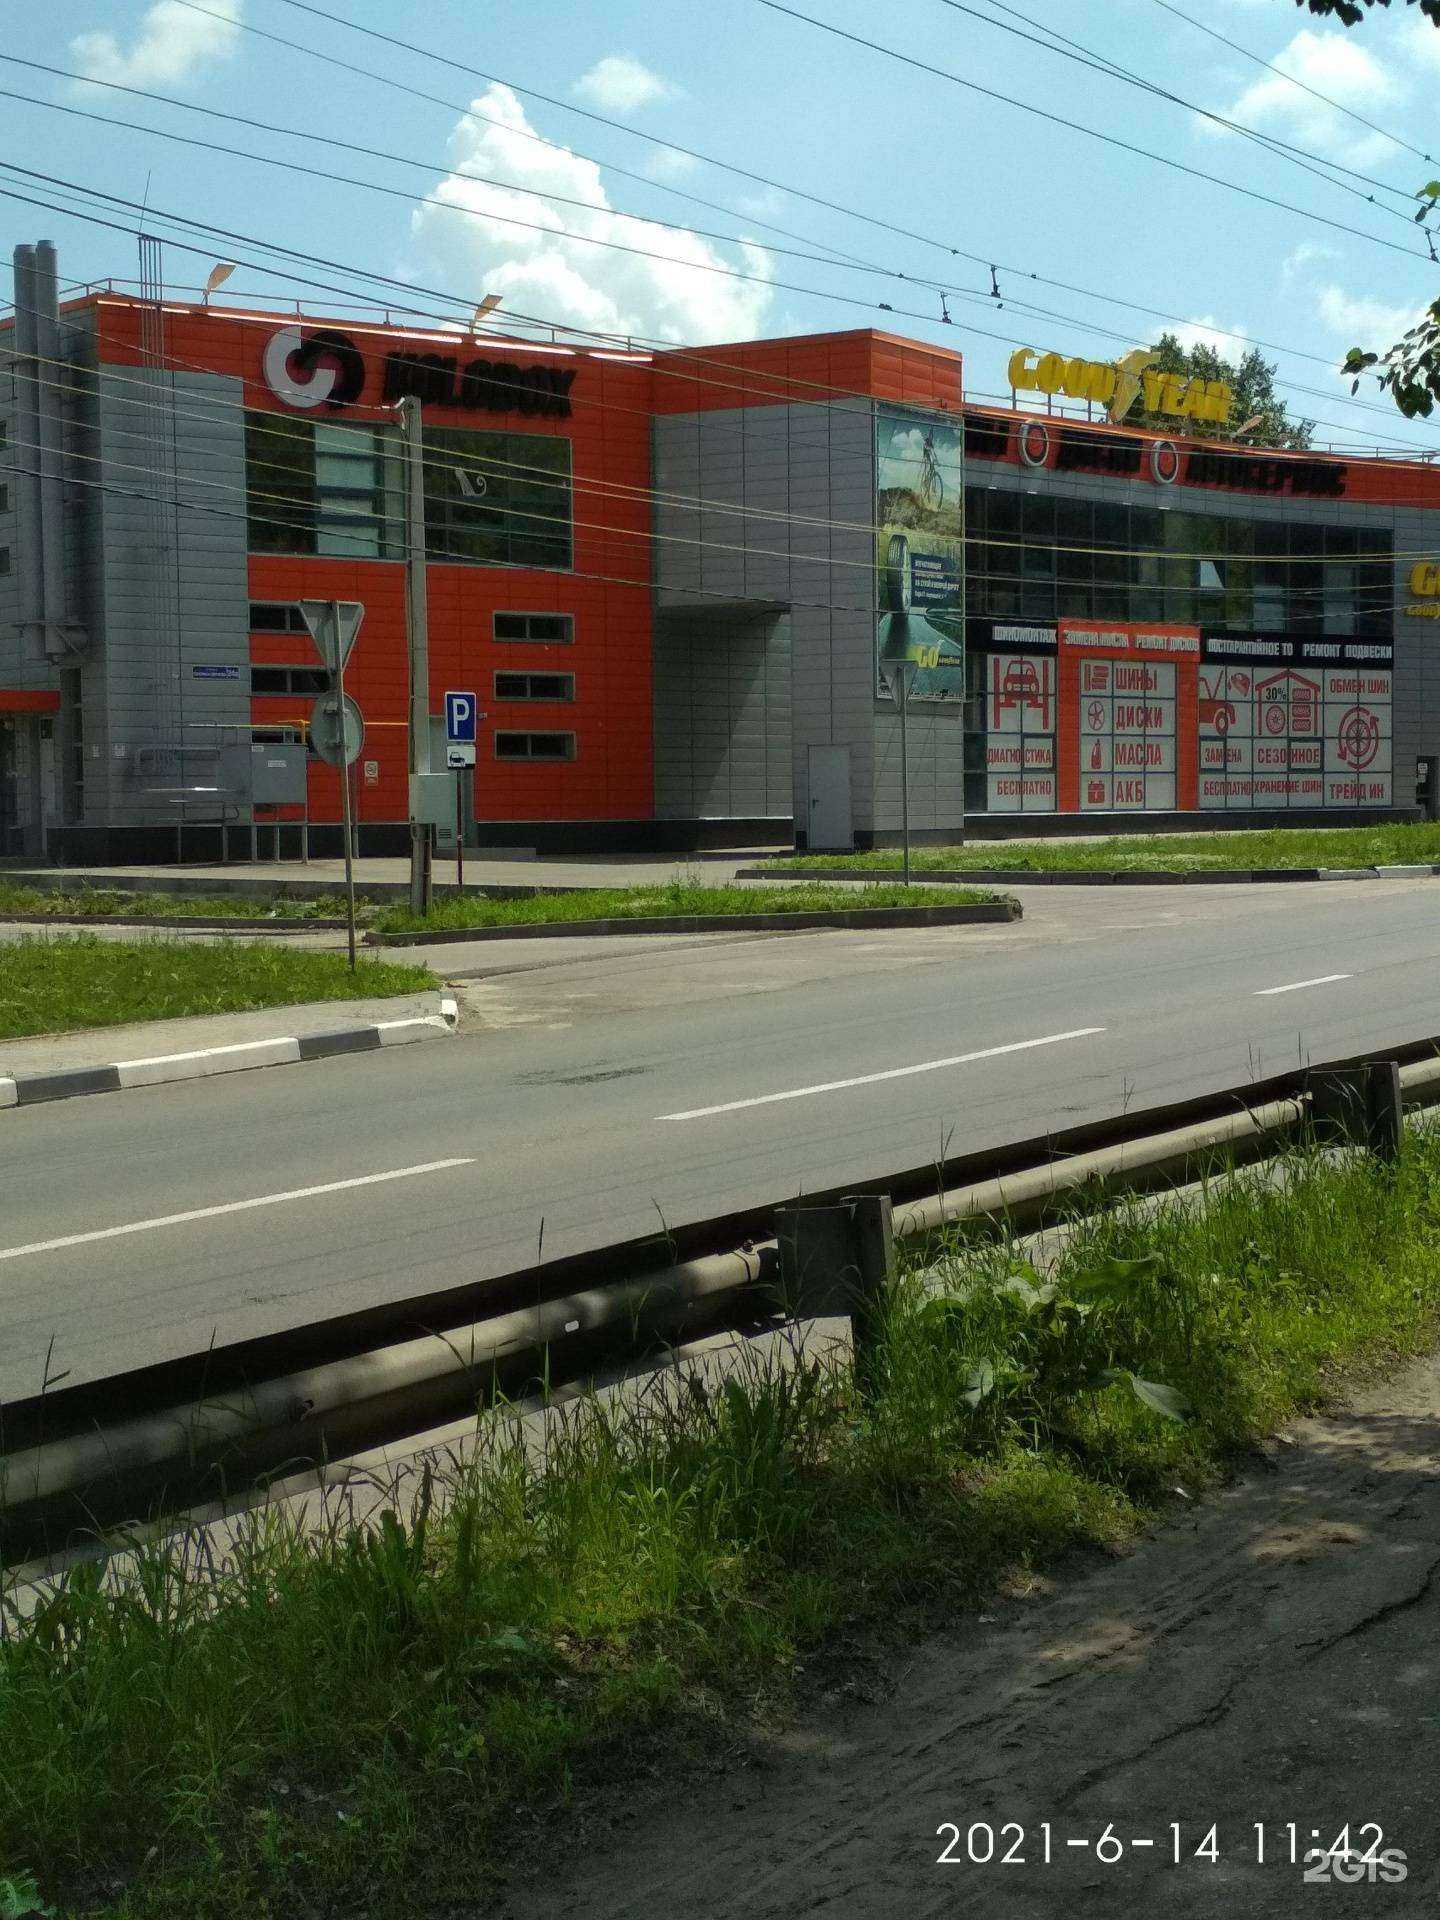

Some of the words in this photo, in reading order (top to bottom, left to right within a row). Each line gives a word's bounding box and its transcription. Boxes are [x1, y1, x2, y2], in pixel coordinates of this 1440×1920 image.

[992, 626, 1057, 643] ШИНОМОНТАЖ
[1135, 635, 1167, 649] РЕМОНТ
[1169, 636, 1199, 652] ДИСКОВ
[1281, 643, 1293, 656] ТО
[1302, 643, 1341, 658] РЕМОНТ
[1345, 645, 1392, 660] ПОДВЕСКИ
[1116, 668, 1157, 691] ШИНЫ
[1330, 679, 1365, 693] ОБМЕН
[1368, 680, 1389, 694] ШИН
[1266, 688, 1287, 700] 30%
[452, 699, 470, 736] P
[1116, 706, 1162, 731] ДИСКИ
[987, 748, 1051, 764] ДИАГНОСТИКА
[1115, 744, 1162, 765] МАСЛА
[1205, 748, 1242, 763] ЗАМЕНА
[1257, 748, 1320, 764] СЕЗОННОЕ
[997, 781, 1051, 795] БЕСПЛАТНО
[1116, 781, 1143, 803] АКБ
[1204, 780, 1252, 796] БЕСПЛАТНО
[1252, 781, 1299, 794] ХРАНЕНИЕ
[1301, 780, 1322, 794] ШИН
[1330, 782, 1367, 801] ТРЕЙД
[1370, 783, 1384, 799] ИН
